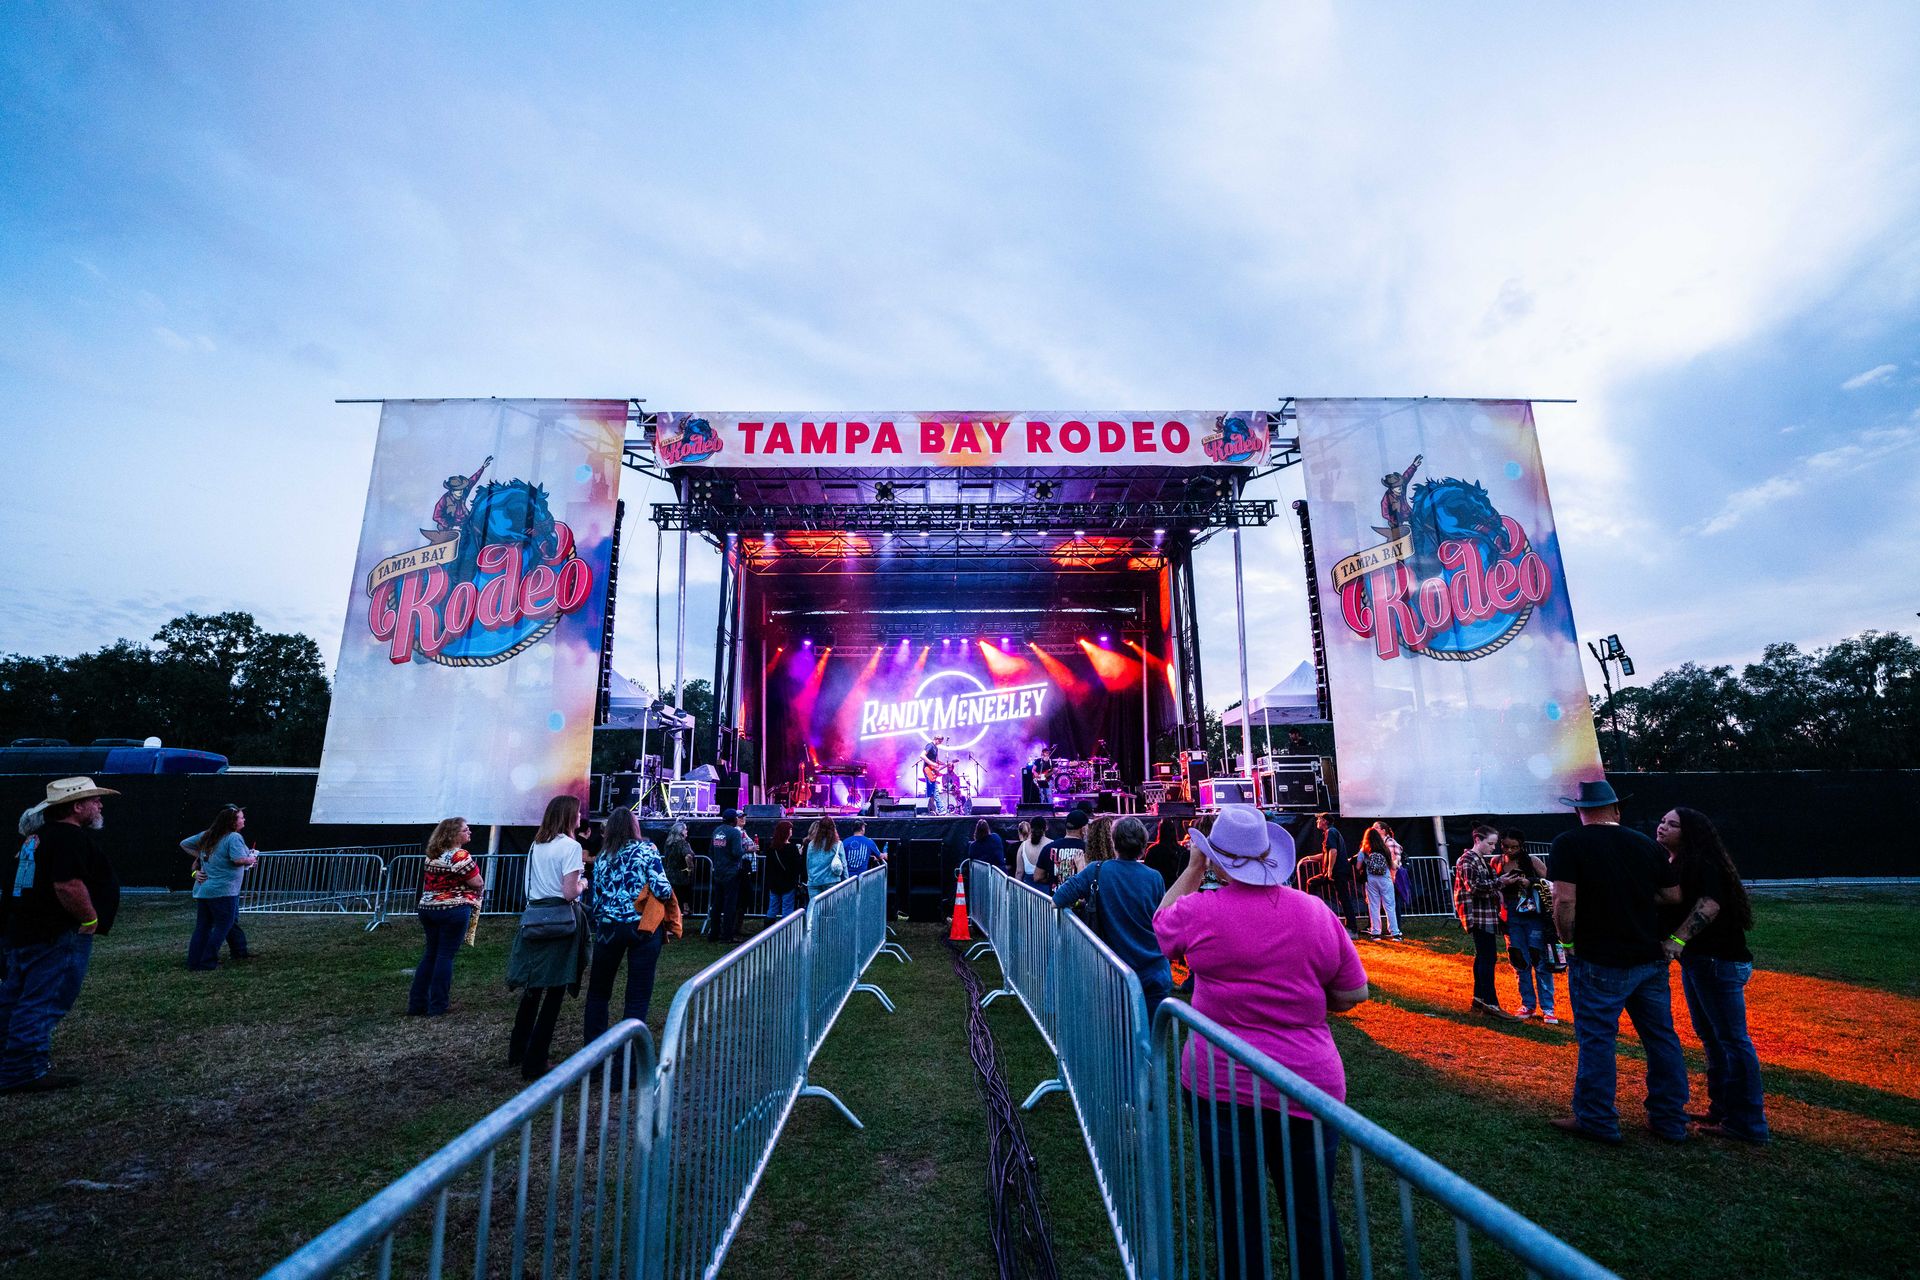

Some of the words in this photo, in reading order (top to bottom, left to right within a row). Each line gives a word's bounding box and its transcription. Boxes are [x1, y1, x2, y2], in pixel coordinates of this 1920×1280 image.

[660, 428, 723, 465] Rodeo
[737, 421, 903, 454] TAMPA
[919, 420, 1010, 454] BAY
[1026, 420, 1190, 454] RODEO
[1203, 428, 1263, 463] Rodeo
[377, 555, 416, 580] TAMPA
[420, 546, 447, 564] BAY
[1340, 553, 1379, 578] TAMPA
[1382, 542, 1404, 561] BAY
[368, 521, 593, 665] Rodeo
[1341, 515, 1552, 660] Rodeo
